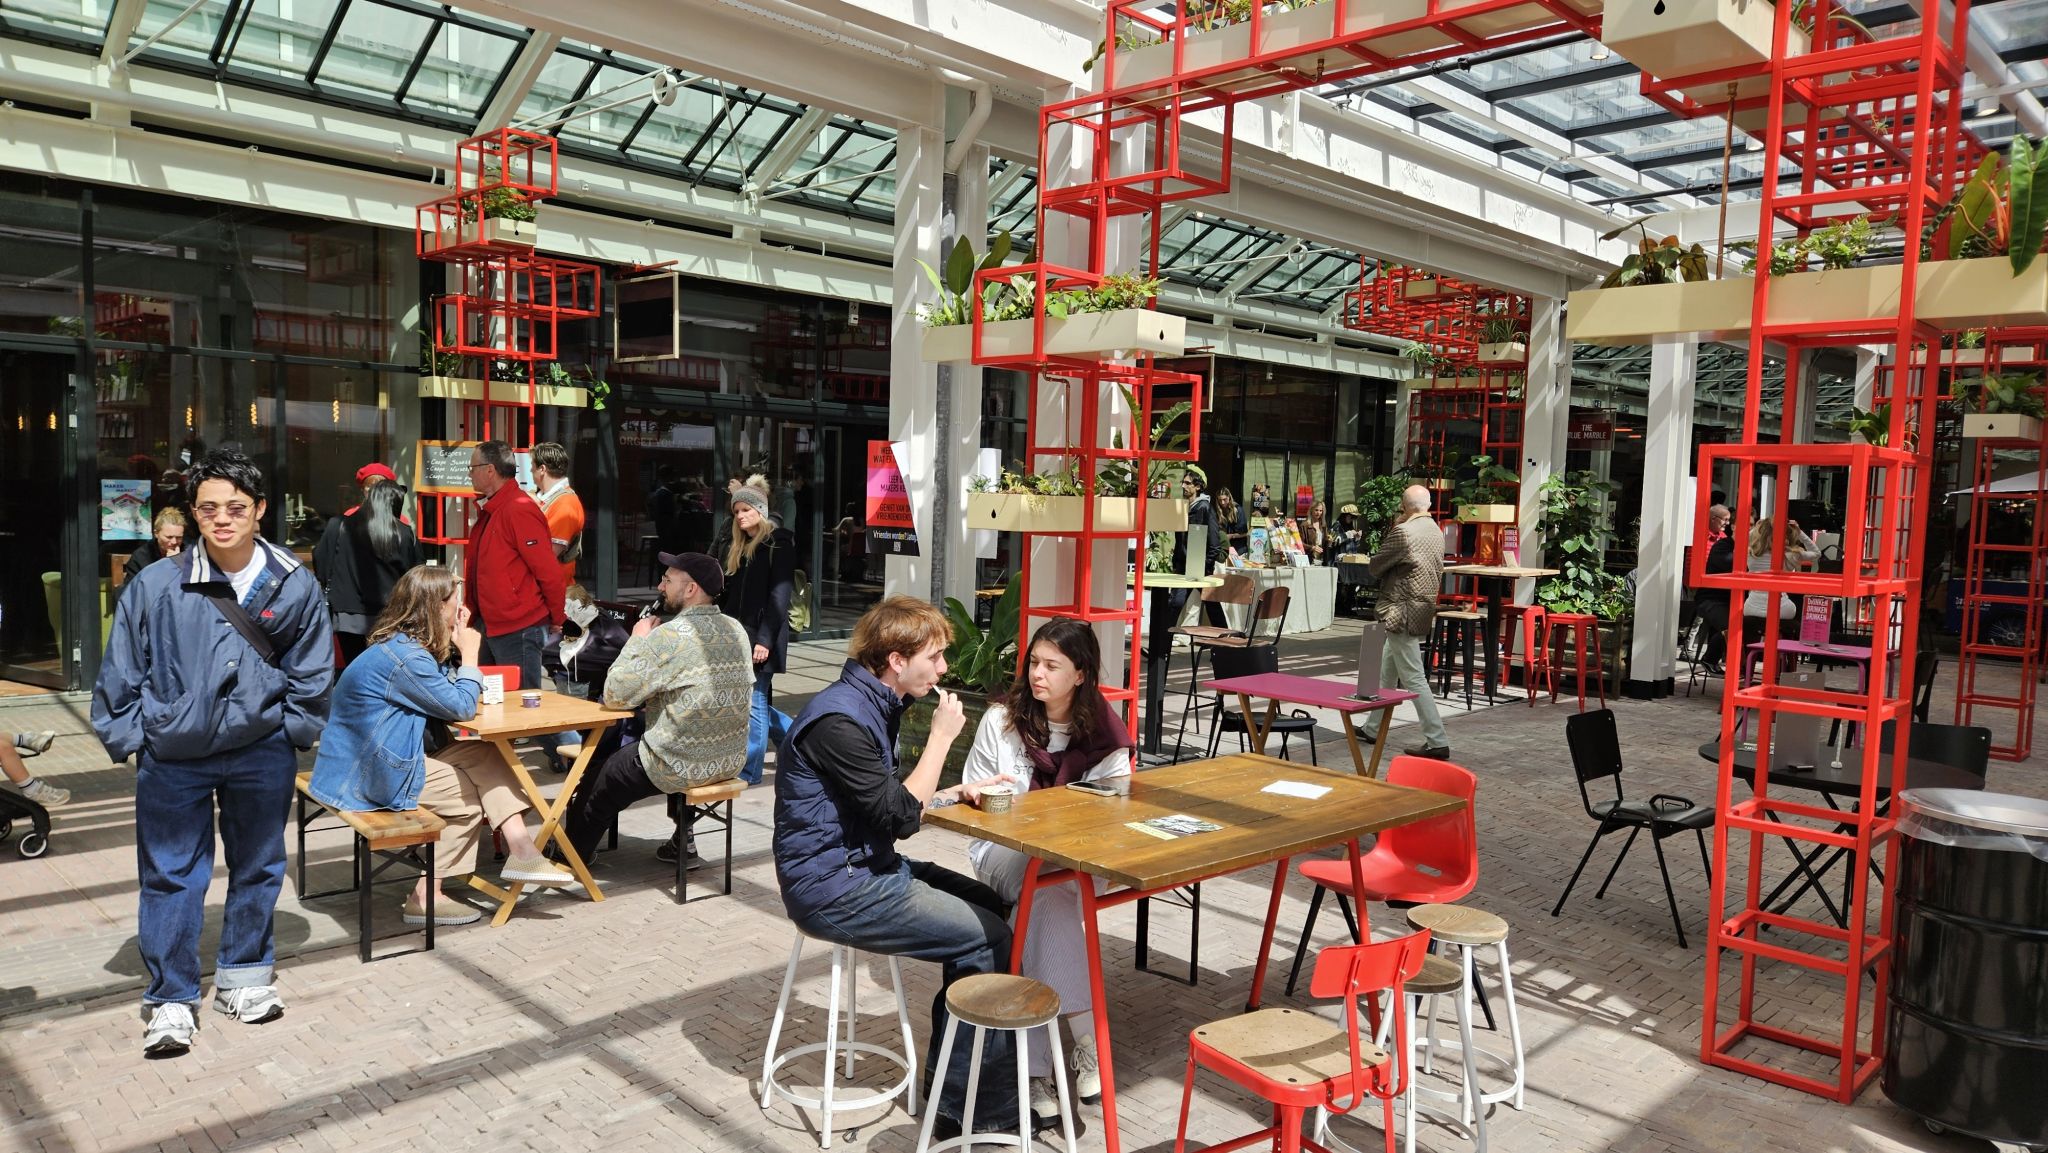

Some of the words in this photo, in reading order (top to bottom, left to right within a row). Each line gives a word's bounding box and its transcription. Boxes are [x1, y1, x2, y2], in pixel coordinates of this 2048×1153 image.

[1807, 598, 1829, 606] DRINKEN
[1807, 605, 1828, 614] DRINKEN
[1805, 612, 1827, 621] DRINKEN
